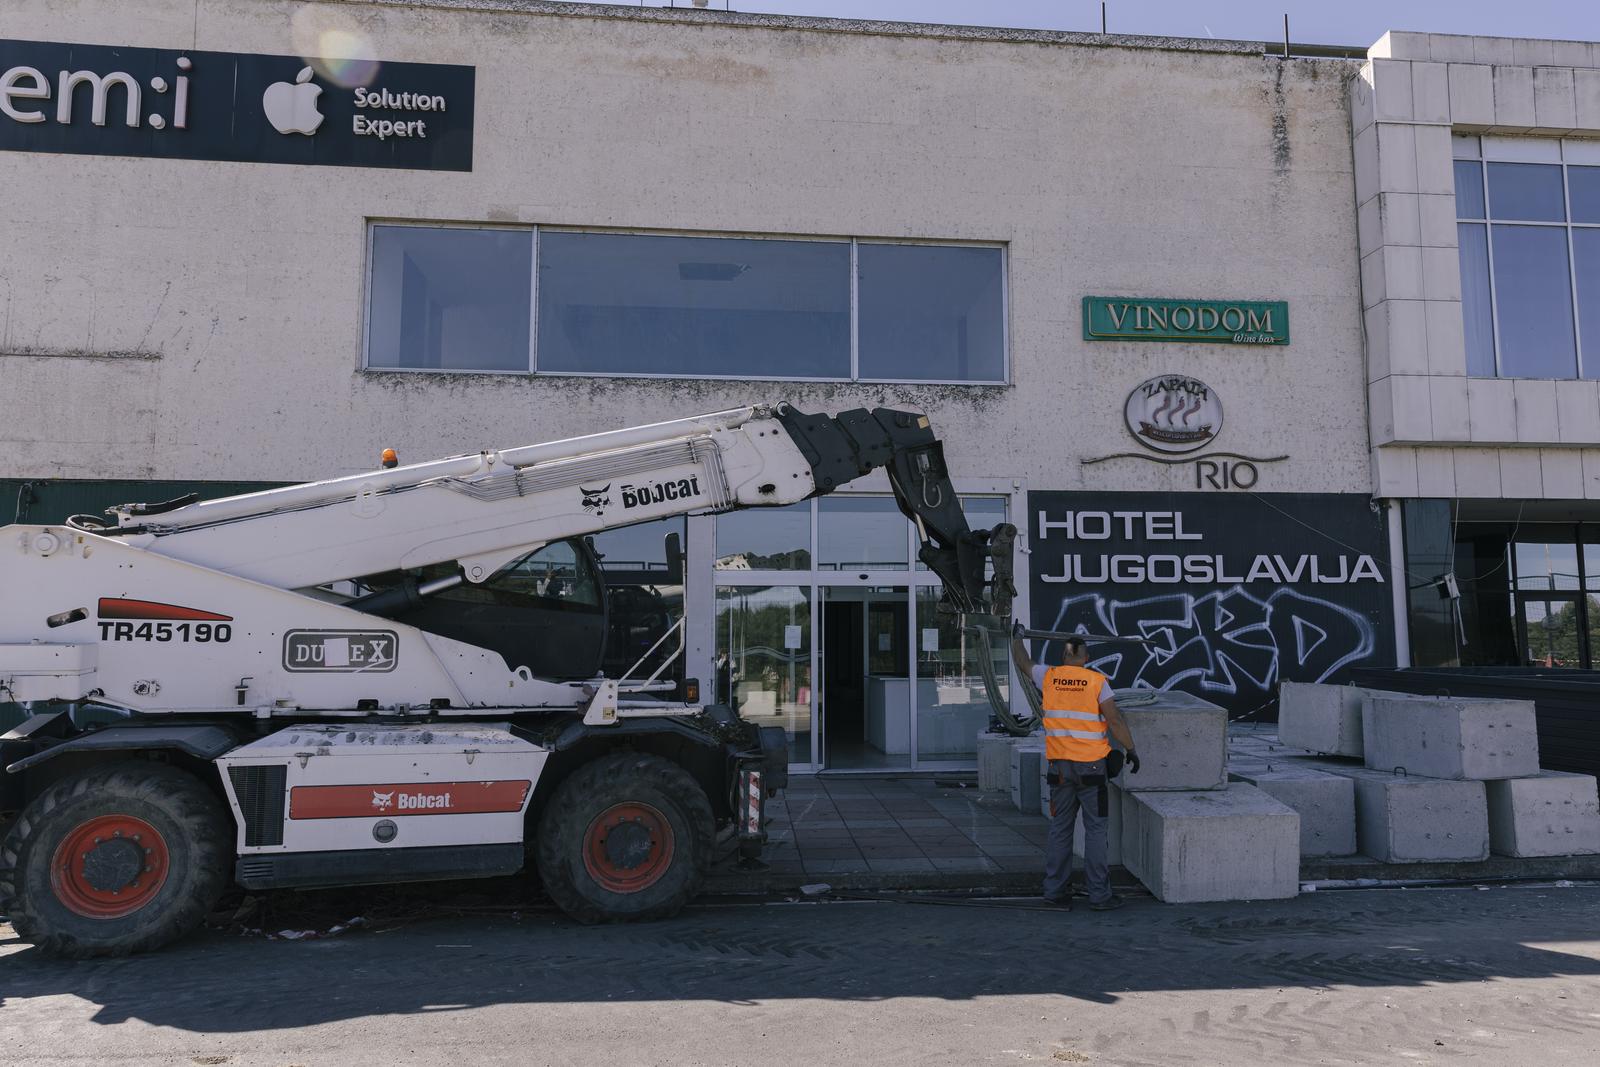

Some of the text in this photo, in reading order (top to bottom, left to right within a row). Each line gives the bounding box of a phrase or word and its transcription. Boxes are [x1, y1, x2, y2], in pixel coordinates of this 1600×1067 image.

[353, 87, 446, 112] Solution
[353, 115, 426, 140] Expert
[1105, 303, 1274, 332] VINODOM
[1258, 334, 1275, 344] bar
[1142, 378, 1208, 402] ZAPATA
[1196, 461, 1258, 489] RIO
[621, 474, 701, 509] Bobcat
[1038, 510, 1203, 540] HOTEL
[1041, 554, 1385, 584] JUGOSLAVIJA
[97, 622, 233, 643] TR45190
[1053, 678, 1088, 686] FIORITO
[398, 793, 451, 809] Bobcat
